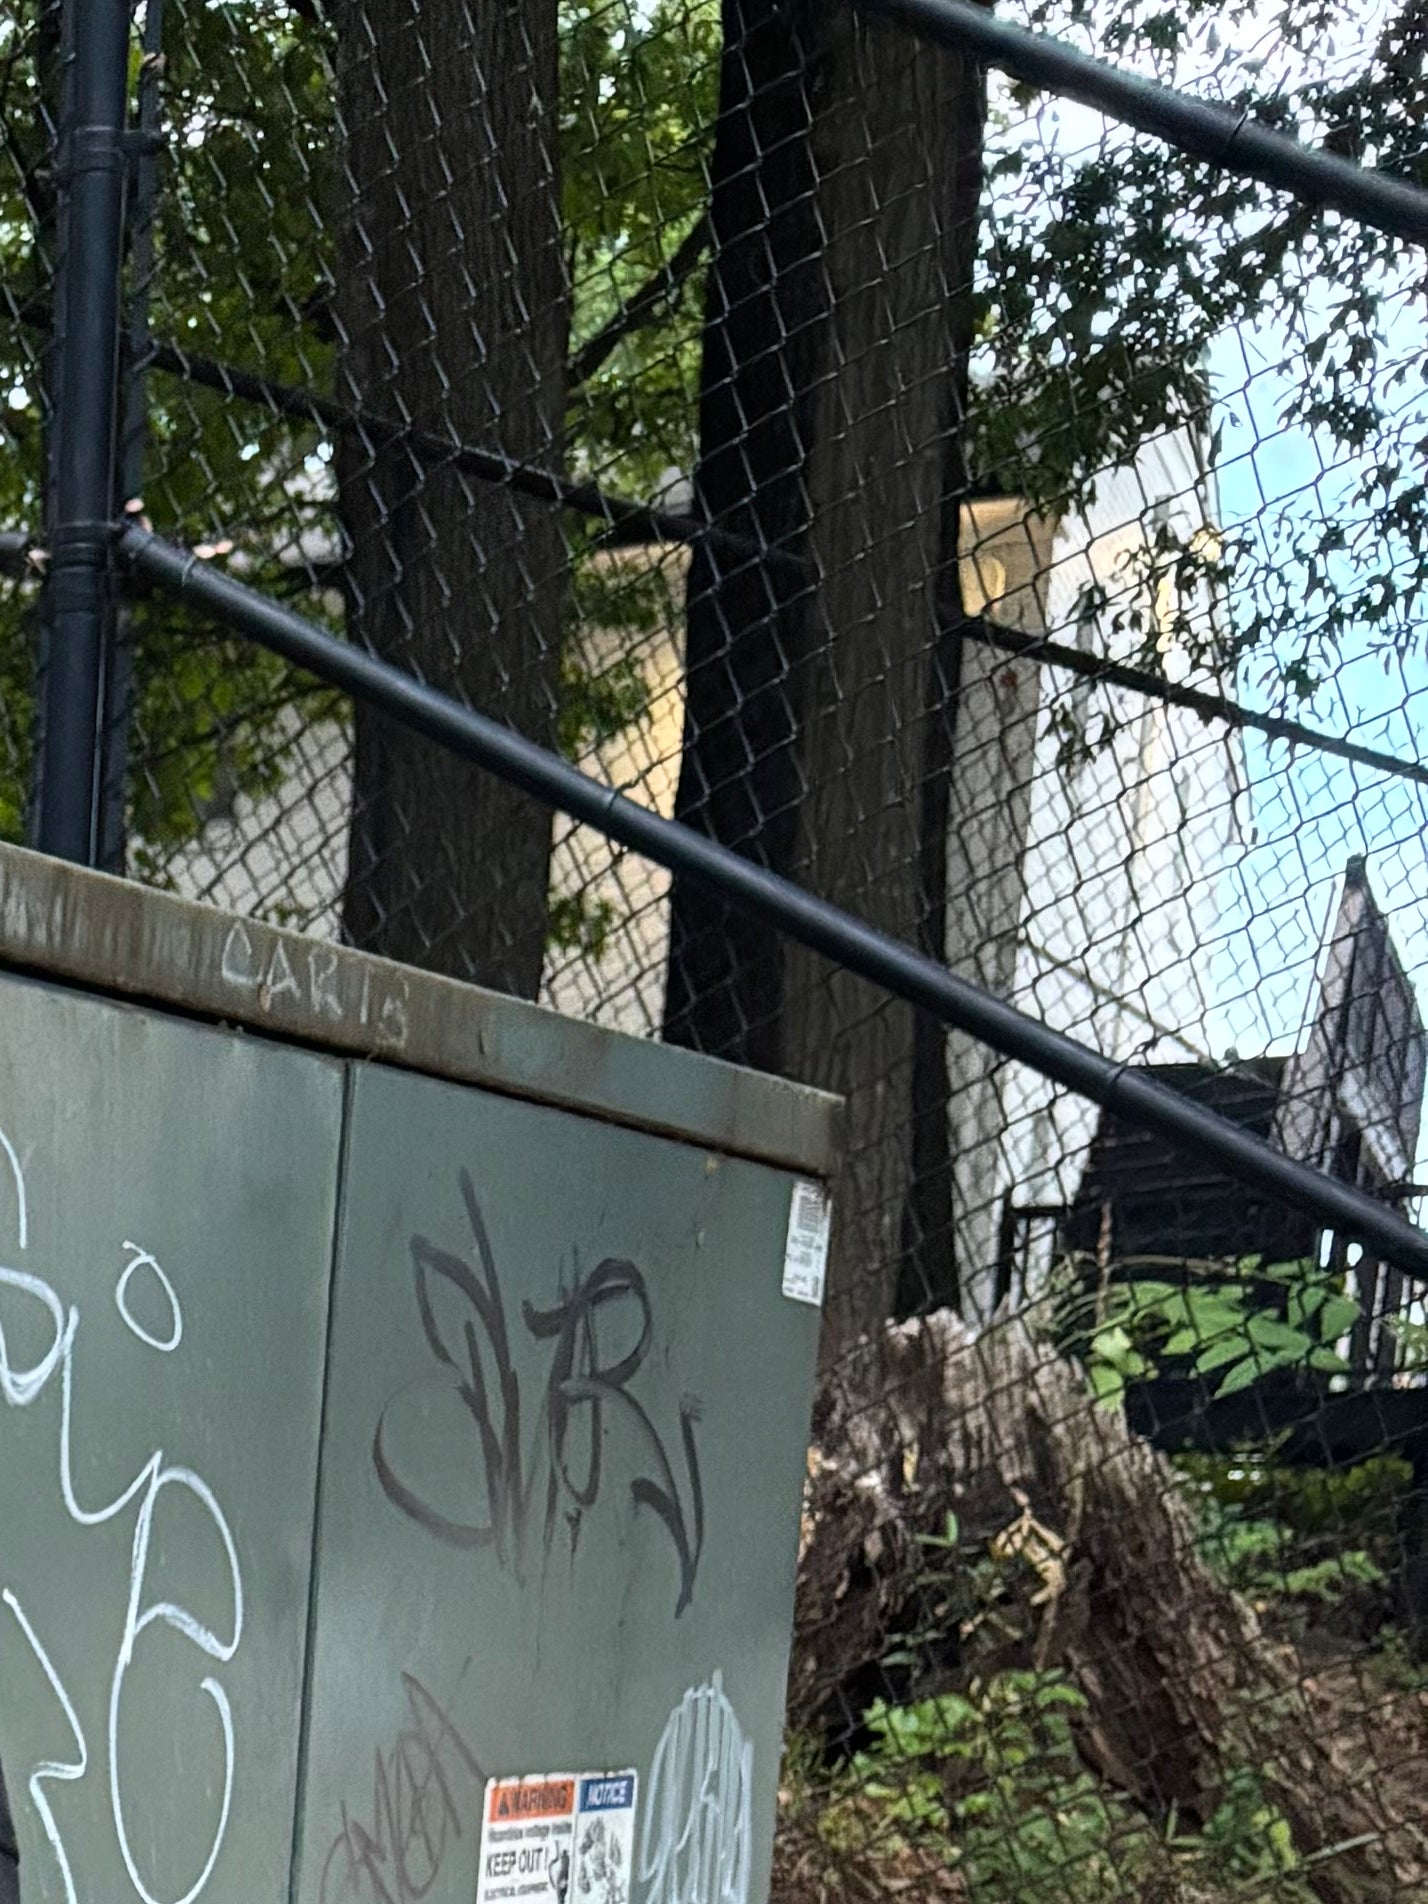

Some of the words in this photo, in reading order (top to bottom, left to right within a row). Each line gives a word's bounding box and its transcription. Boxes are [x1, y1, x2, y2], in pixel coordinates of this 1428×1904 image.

[511, 1786, 568, 1812] WARNING
[588, 1780, 628, 1806] NOTICE
[485, 1851, 517, 1877] KEEP
